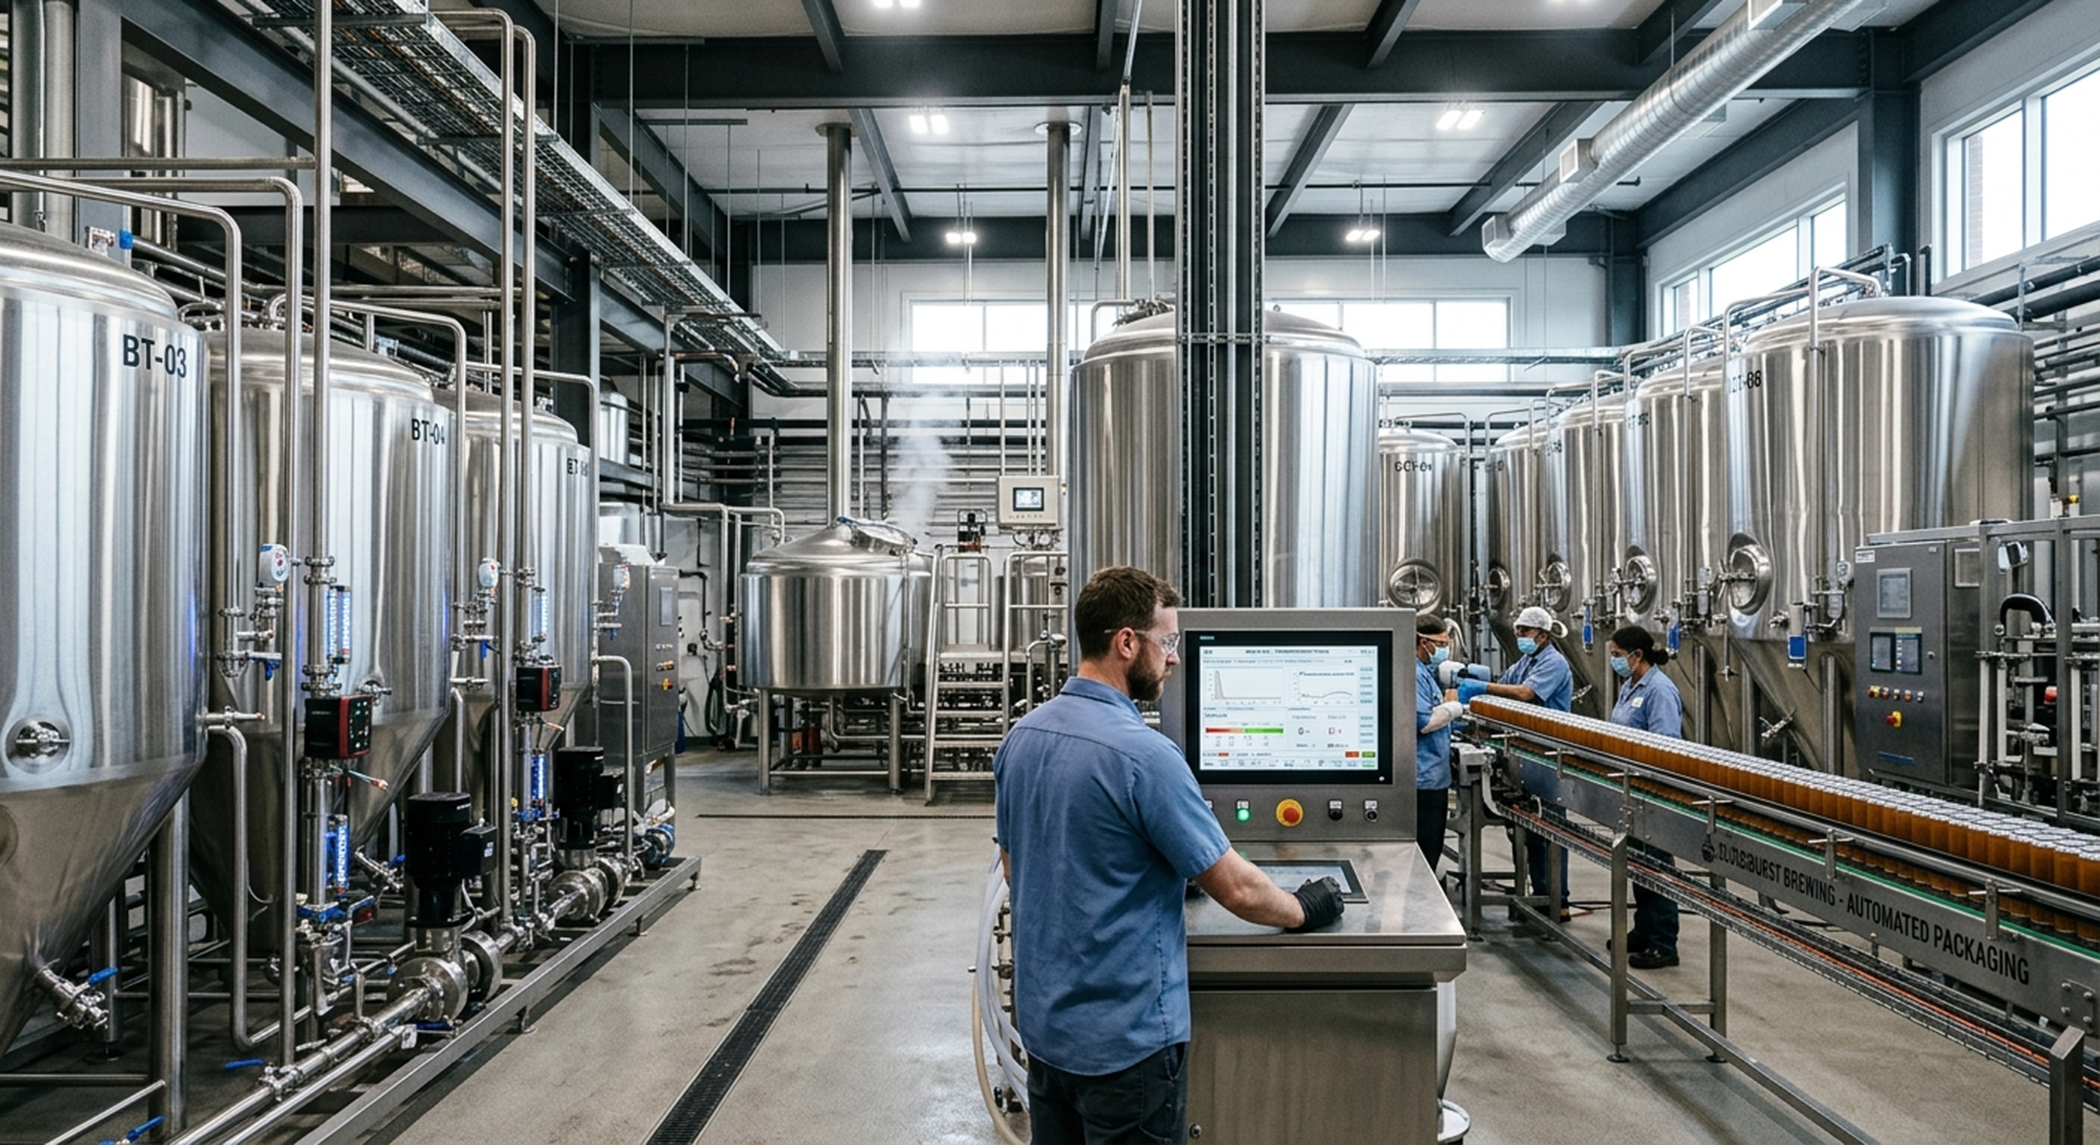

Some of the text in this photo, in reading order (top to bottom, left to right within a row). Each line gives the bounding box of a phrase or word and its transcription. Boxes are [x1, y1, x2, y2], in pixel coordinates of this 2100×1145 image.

[123, 333, 187, 379] BT-03
[1783, 867, 1836, 907] BREWING
[1847, 892, 1930, 944] AUTOMATED
[1934, 924, 2030, 985] PACKAGING
